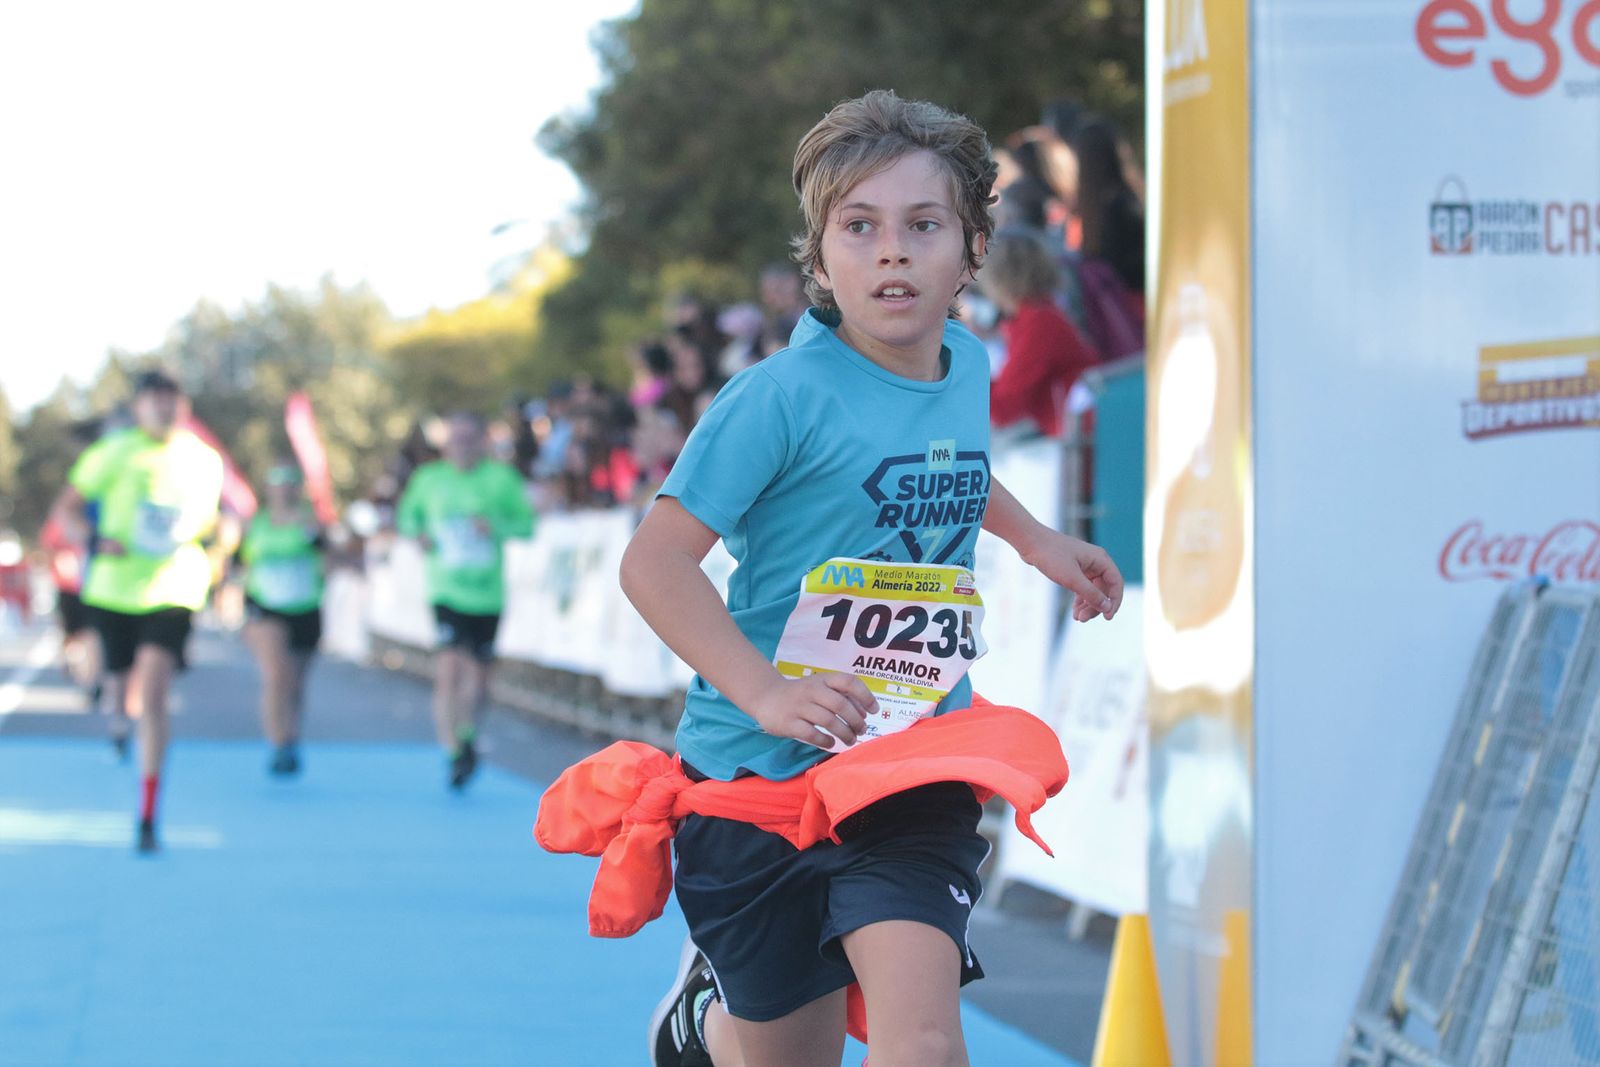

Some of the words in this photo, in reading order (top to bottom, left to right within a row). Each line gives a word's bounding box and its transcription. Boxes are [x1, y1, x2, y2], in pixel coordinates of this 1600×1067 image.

[895, 470, 984, 501] SUPER
[875, 497, 987, 528] RUNNER
[872, 579, 913, 591] Almería
[915, 581, 941, 593] 2022
[874, 569, 903, 579] Medio
[906, 570, 941, 581] Maratón
[821, 598, 977, 660] 10235
[852, 655, 941, 682] AIRAMOR
[854, 669, 875, 678] AIRAM
[876, 672, 903, 682] ORCERA
[904, 677, 934, 687] VALDIVIA
